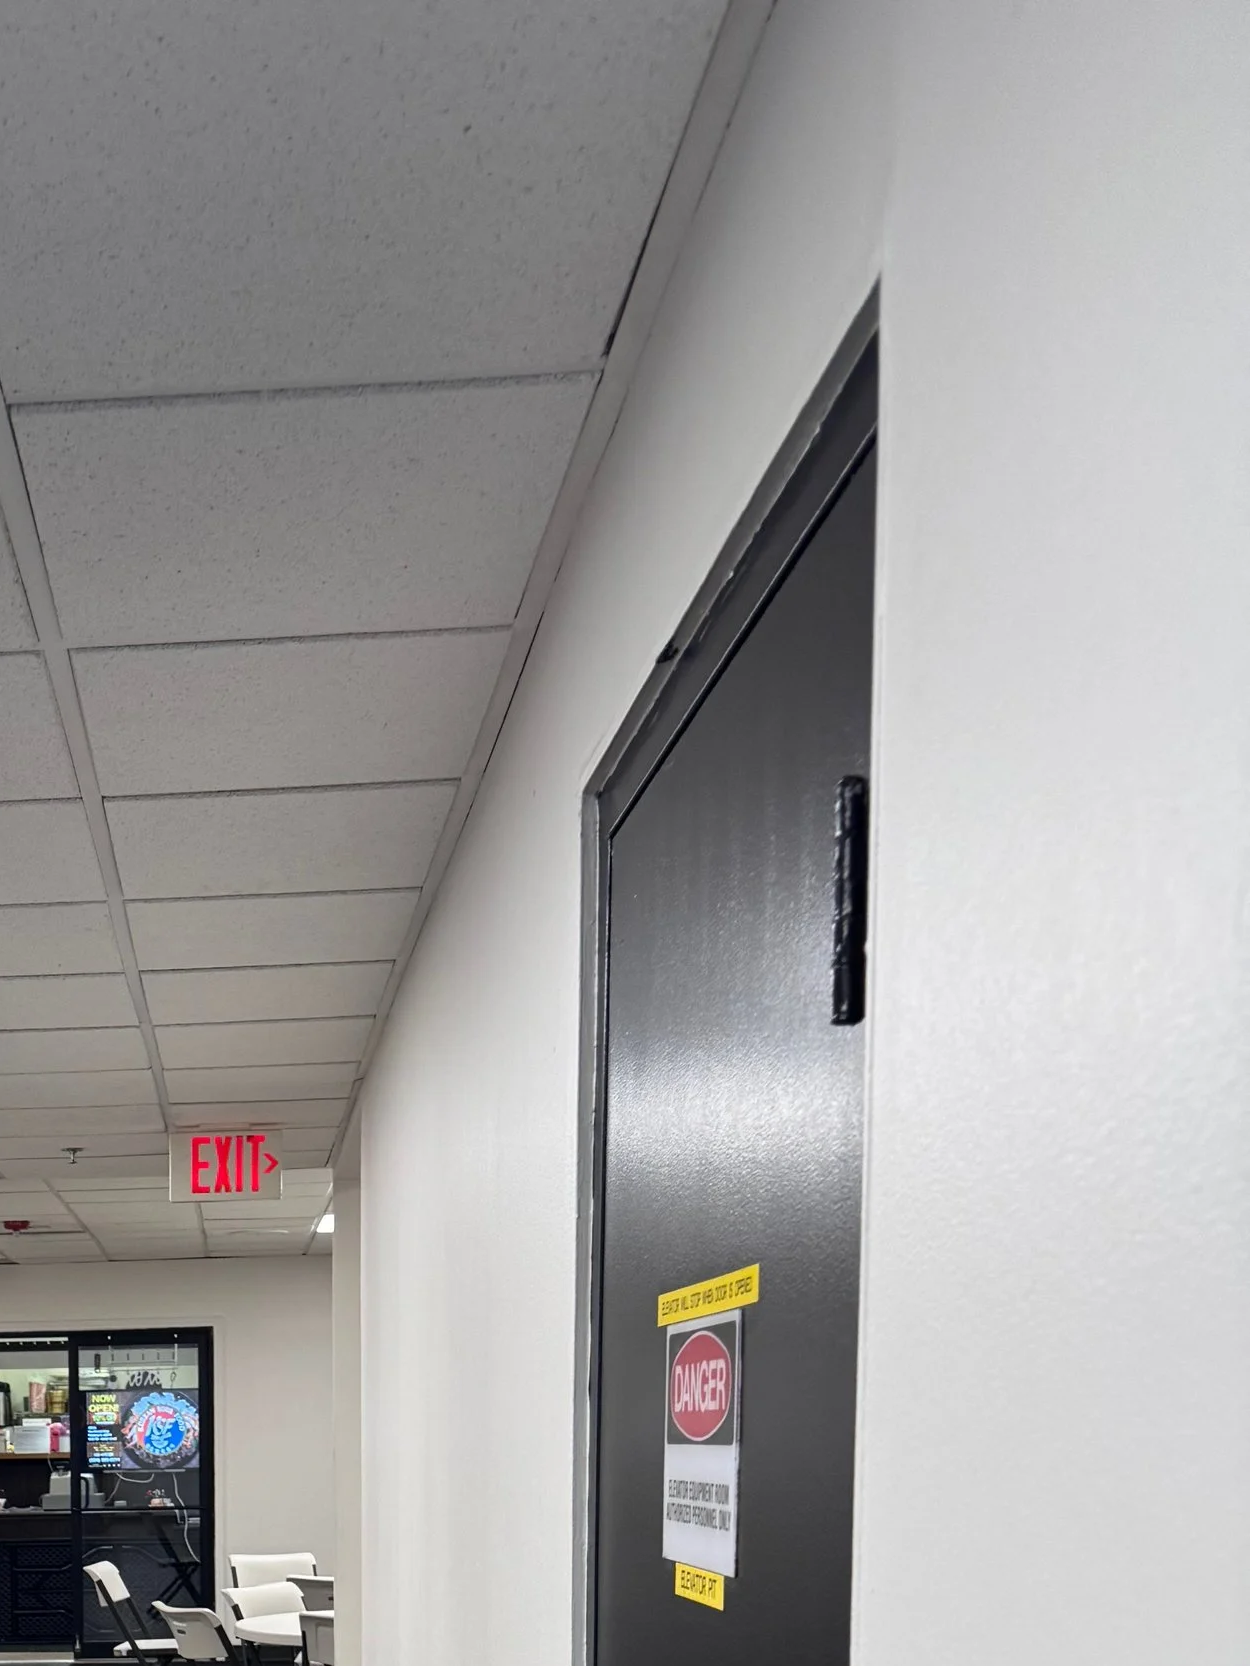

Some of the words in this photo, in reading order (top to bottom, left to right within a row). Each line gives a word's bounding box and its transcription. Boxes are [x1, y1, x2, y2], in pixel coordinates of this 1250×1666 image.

[191, 1135, 266, 1194] EXIT
[662, 1298, 680, 1316] ELEVATOR
[680, 1295, 689, 1311] WILL
[690, 1292, 701, 1309] STOP
[702, 1288, 714, 1304] WHEN
[715, 1285, 727, 1302] DOOR
[729, 1282, 734, 1299] IS
[735, 1276, 753, 1297] OPENED
[91, 1394, 117, 1403] NOW
[674, 1358, 726, 1413] DANGER
[669, 1479, 688, 1499] ELEVATOR
[689, 1481, 714, 1503] EQUIPMENT
[715, 1484, 729, 1505] ROOM
[667, 1502, 691, 1523] AUTHORIZED
[692, 1505, 717, 1529] PERSONNEL
[719, 1510, 731, 1531] ONLY
[681, 1570, 706, 1596] ELEVATOR
[708, 1578, 717, 1599] PIT
